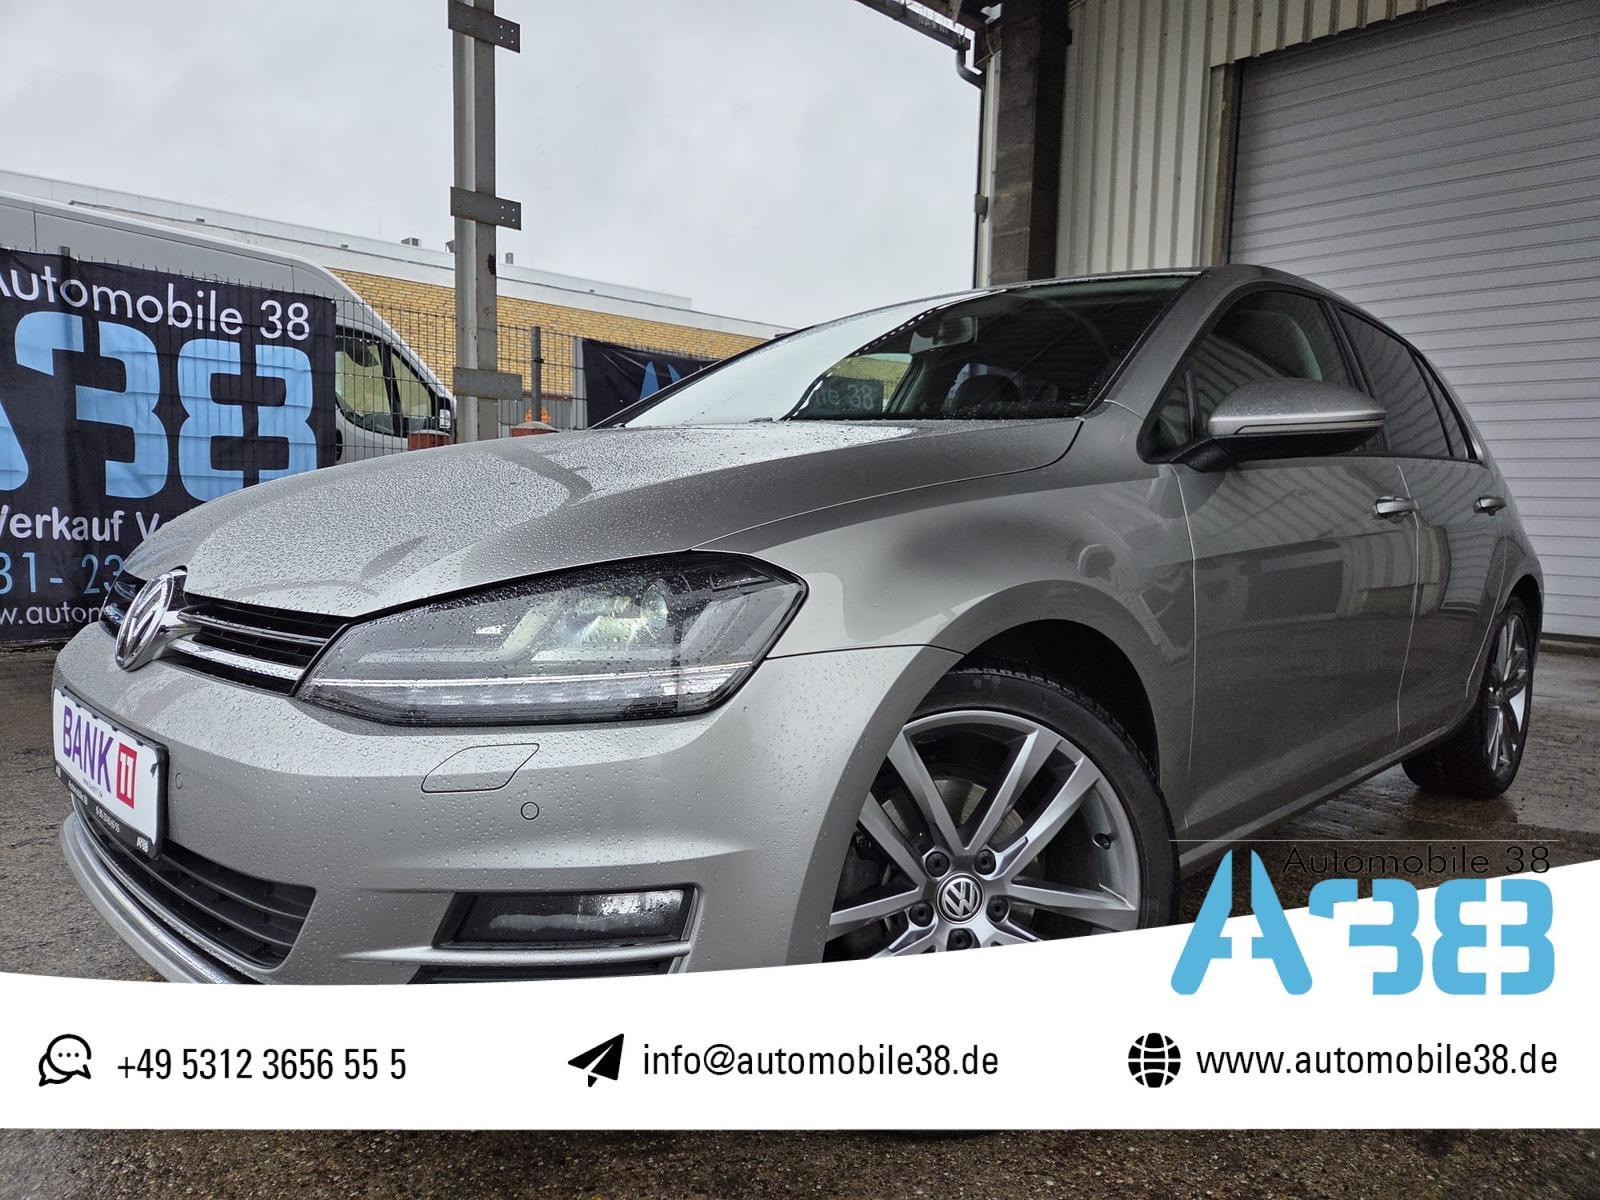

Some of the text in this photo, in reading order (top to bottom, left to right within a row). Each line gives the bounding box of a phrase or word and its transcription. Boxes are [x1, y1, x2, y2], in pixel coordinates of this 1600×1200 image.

[0, 266, 310, 342] utomobile 38
[64, 705, 136, 803] BANK 11
